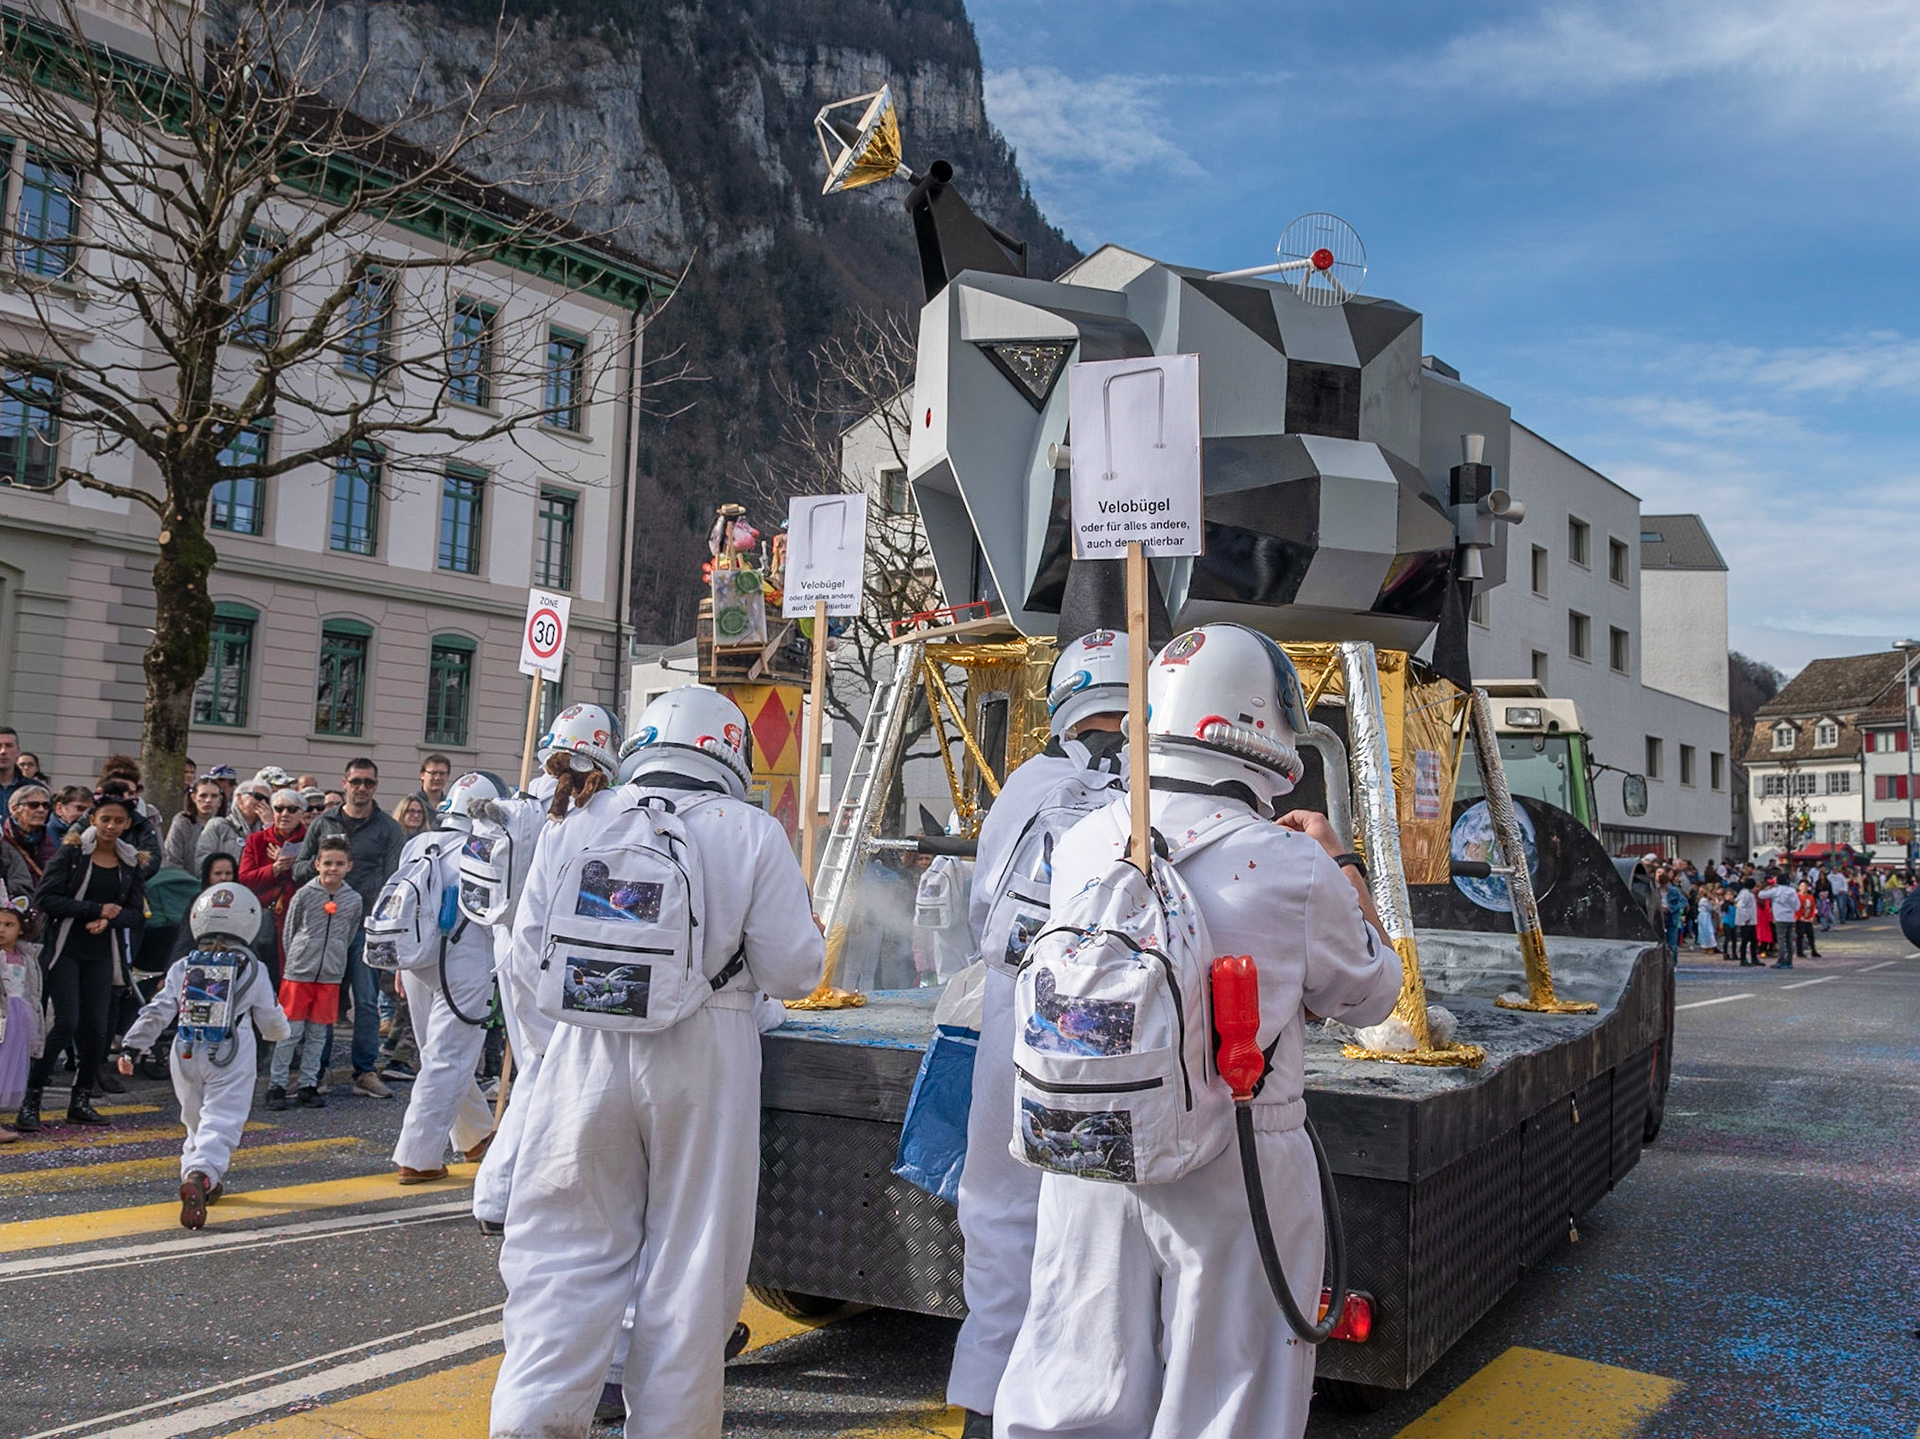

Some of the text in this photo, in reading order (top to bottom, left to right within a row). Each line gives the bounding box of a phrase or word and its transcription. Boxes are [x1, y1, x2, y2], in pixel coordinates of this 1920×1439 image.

[1098, 498, 1170, 515] Velobügel
[1081, 519, 1190, 532] oder für alles andere,
[1087, 538, 1111, 548] auch
[801, 580, 845, 590] Velobügel
[540, 597, 559, 608] ZONE
[809, 603, 851, 611] dntierbar
[534, 620, 556, 646] 30
